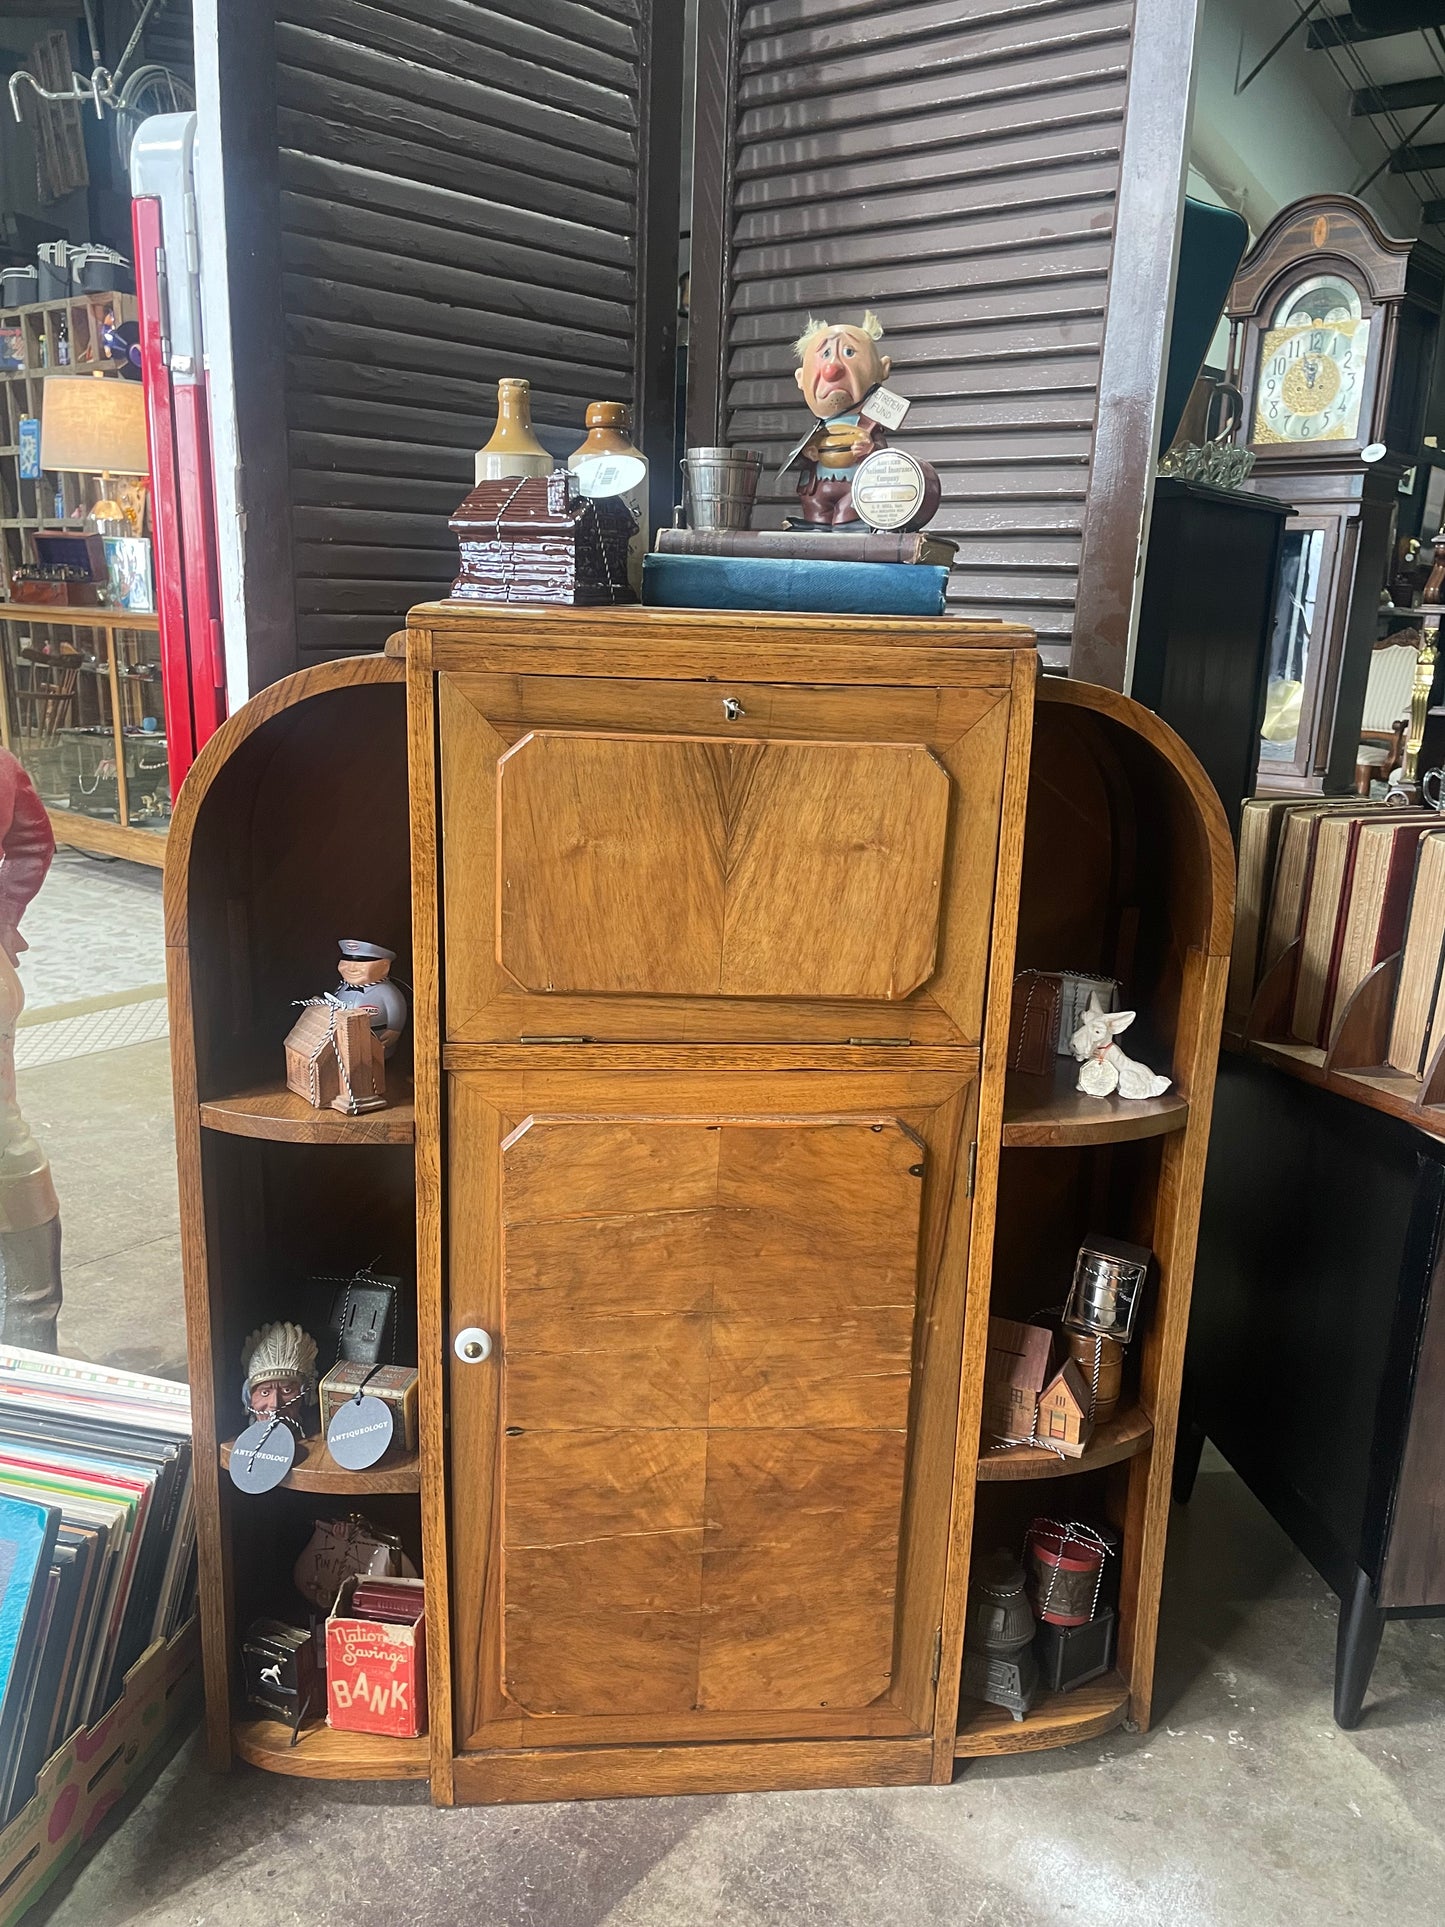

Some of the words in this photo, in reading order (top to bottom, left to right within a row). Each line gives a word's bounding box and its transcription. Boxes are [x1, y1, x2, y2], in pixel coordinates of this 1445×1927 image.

[1289, 340, 1300, 358] 11
[1309, 332, 1323, 351] 12
[1332, 337, 1337, 355] 1
[1273, 357, 1286, 376] 10
[1344, 350, 1353, 369] 2
[1267, 379, 1276, 397] 9
[1346, 372, 1356, 391] 3
[874, 390, 904, 412] ETIREMENT
[1269, 401, 1279, 419] 8
[1337, 394, 1347, 412] 4
[870, 402, 892, 419] FUND
[1284, 415, 1292, 435] 7
[1301, 419, 1310, 436] 6
[1321, 411, 1331, 429] 5
[330, 1421, 389, 1443] ANTIQUEOLOGY
[233, 1448, 290, 1463] ANTIUEOLOGY
[342, 1643, 408, 1673] Savings
[331, 1672, 409, 1716] BANK
